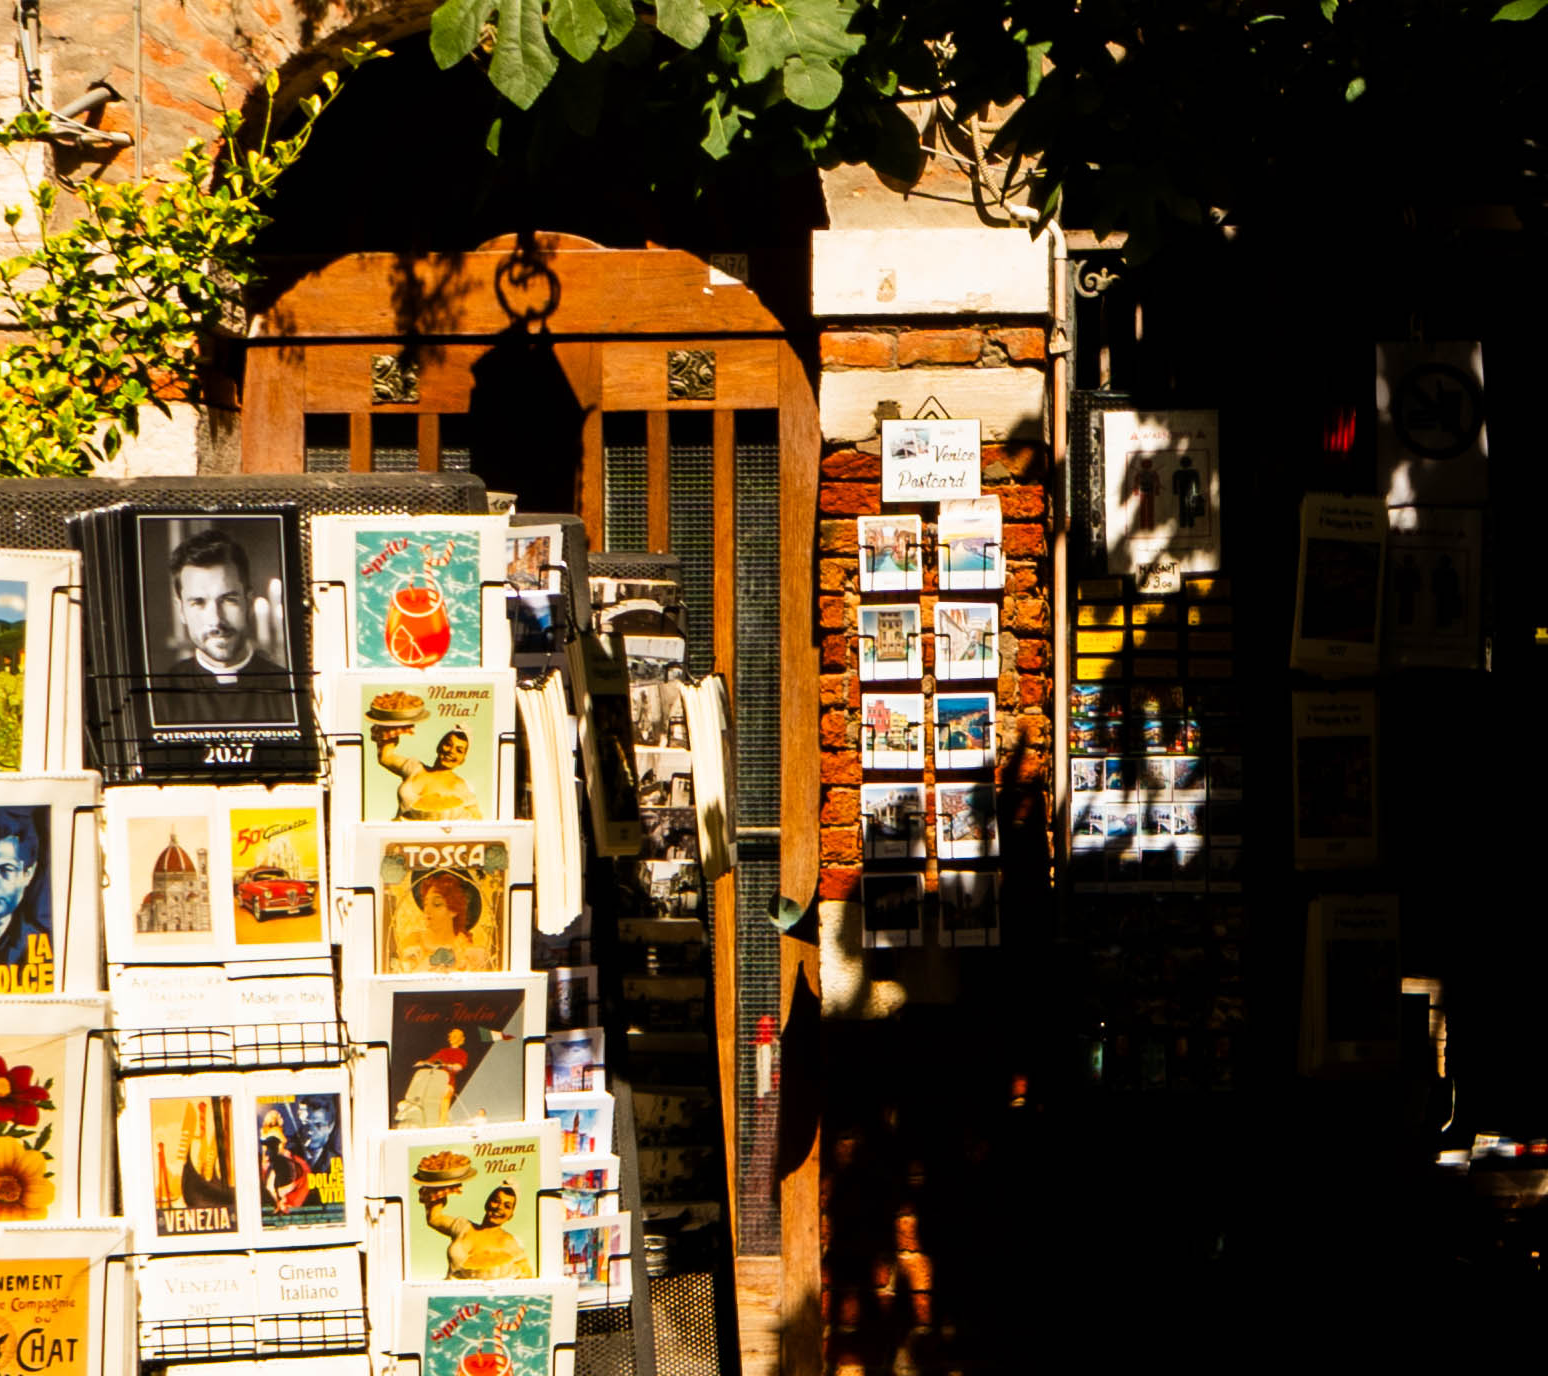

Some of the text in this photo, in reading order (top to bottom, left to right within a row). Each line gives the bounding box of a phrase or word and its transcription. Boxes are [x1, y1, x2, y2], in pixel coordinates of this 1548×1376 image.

[932, 443, 977, 464] Venice
[897, 469, 967, 491] Postcard
[360, 537, 410, 580] Spritz
[428, 685, 491, 701] Mamma
[437, 702, 479, 718] Mia!
[152, 729, 302, 744] CALENDARIO GREGORIANO
[202, 743, 256, 764] 2027
[403, 844, 486, 869] TOSCA
[27, 933, 54, 965] LA
[241, 990, 282, 1005] Made
[301, 989, 327, 1007] Italy
[473, 1142, 537, 1158] Mamma
[330, 1157, 343, 1173] LA
[484, 1157, 525, 1175] Mia!
[308, 1172, 345, 1189] DOLCE
[320, 1188, 346, 1205] VITA
[162, 1206, 232, 1234] VENEZIA
[277, 1264, 338, 1281] Cinema
[164, 1278, 242, 1296] VENEZIA
[280, 1284, 340, 1302] Italiano
[10, 1296, 76, 1315] Compagnie
[430, 1302, 482, 1345] Spritz
[15, 1327, 80, 1373] CHAT
